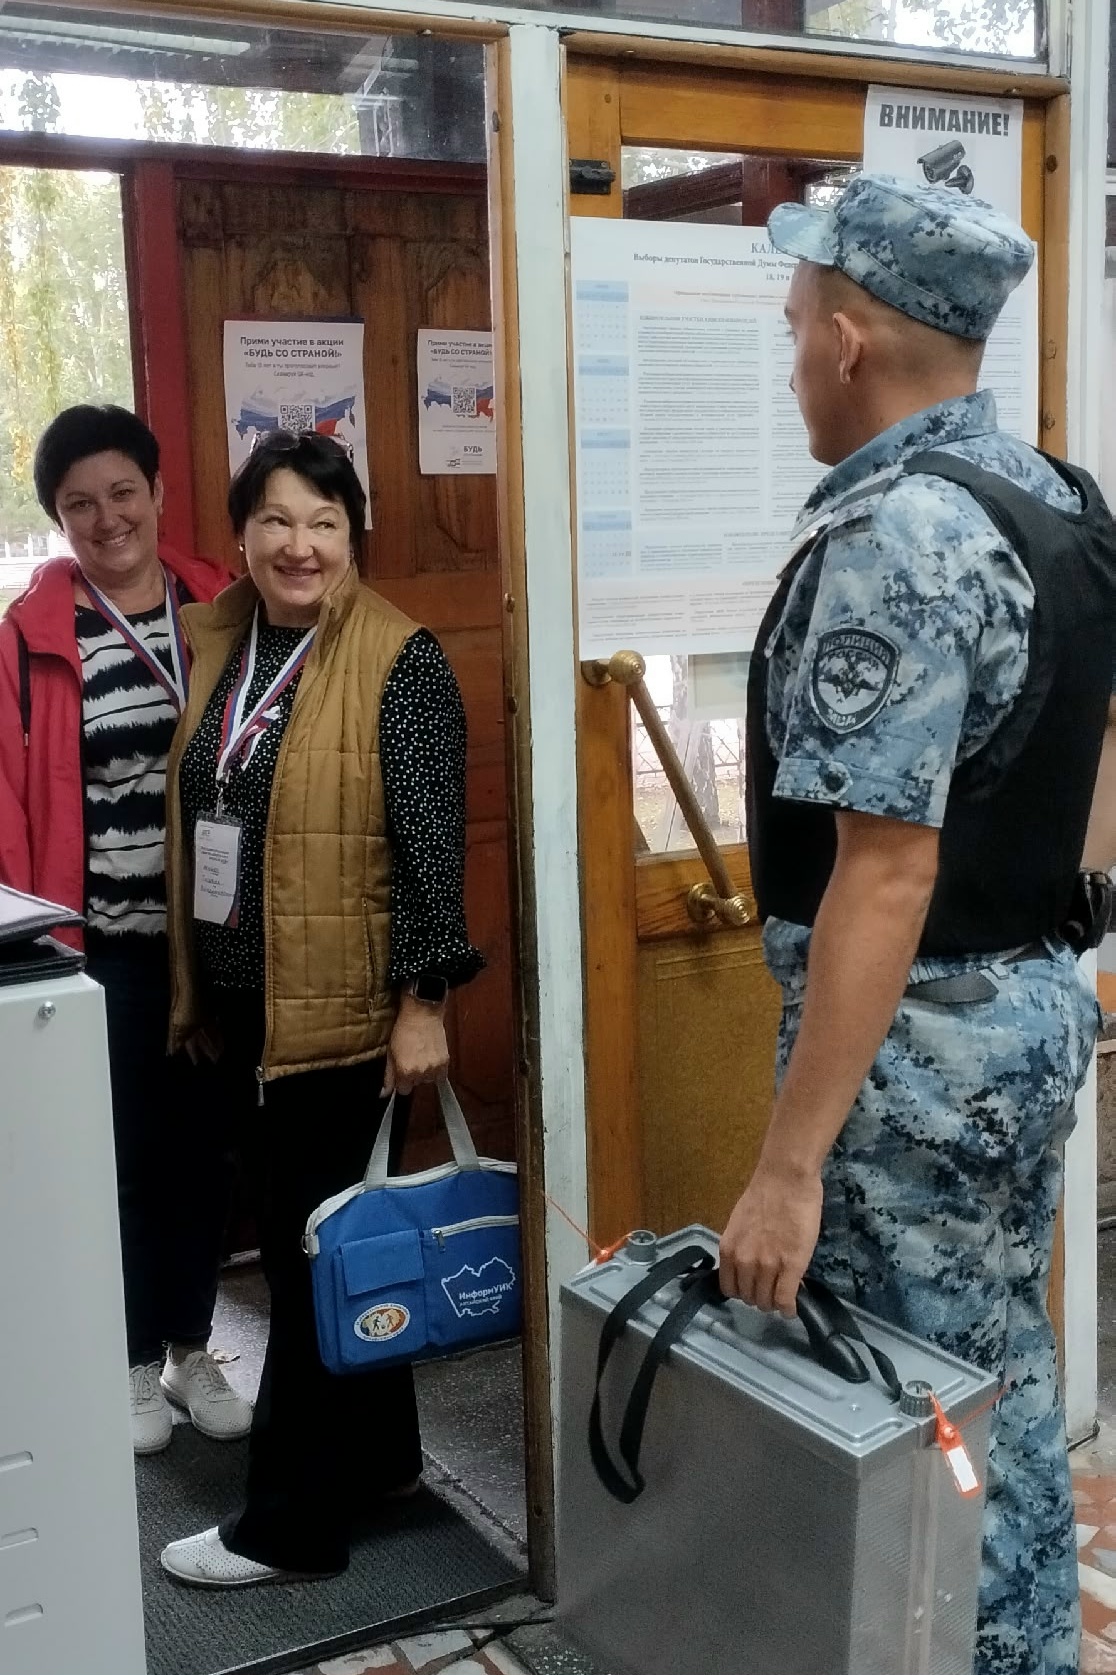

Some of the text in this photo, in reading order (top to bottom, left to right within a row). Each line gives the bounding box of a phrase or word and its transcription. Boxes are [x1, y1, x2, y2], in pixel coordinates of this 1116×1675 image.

[879, 104, 1010, 136] ВНИМАНИЕ!
[633, 254, 663, 262] Выборы
[664, 256, 699, 266] депутатов
[700, 256, 756, 267] Государственной
[757, 258, 777, 268] Думы
[240, 337, 270, 346] Прими
[271, 339, 308, 347] участие
[317, 339, 344, 347] акции
[244, 349, 273, 358] «БУДЬ
[275, 349, 289, 358] СО
[463, 445, 483, 453] БУДЬ
[459, 1283, 513, 1301] ИнформУИК
